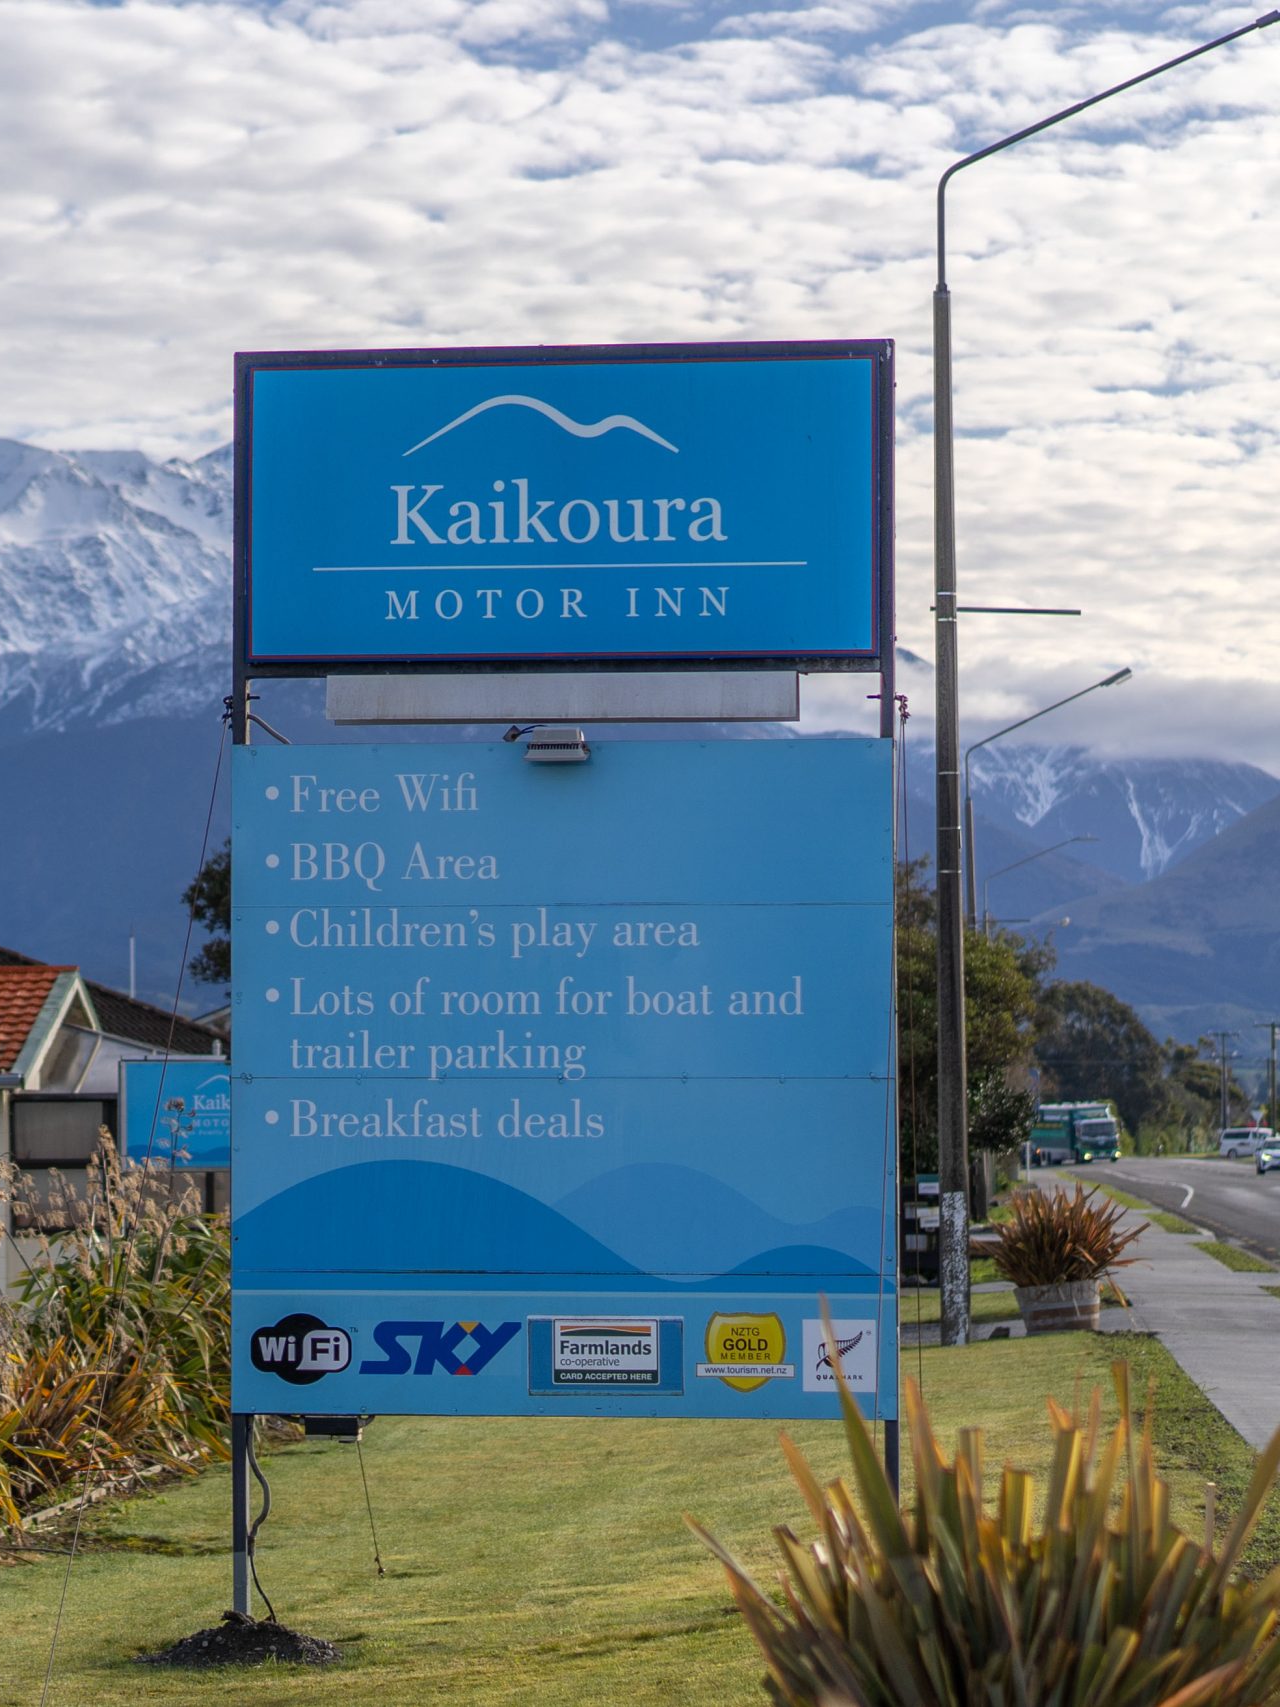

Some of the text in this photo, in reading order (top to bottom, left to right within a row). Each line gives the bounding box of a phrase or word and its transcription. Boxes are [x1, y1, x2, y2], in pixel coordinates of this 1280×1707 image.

[390, 479, 728, 545] Kaikoura
[385, 586, 730, 620] MOTOR INN
[290, 772, 479, 813] Free Wifi
[290, 842, 499, 891] BBQ Area
[290, 908, 701, 958] Children's play area
[290, 976, 804, 1016] Lots of room for boat and
[290, 1030, 586, 1080] trailer parking
[290, 1098, 605, 1138] Breakfast deals
[359, 1321, 522, 1375] SKY
[560, 1340, 652, 1355] Farmlands
[723, 1339, 768, 1351] GOLD
[731, 1327, 760, 1336] NZTG
[560, 1357, 620, 1367] co-operative
[704, 1366, 787, 1374] www.tourism.net.nz
[720, 1352, 771, 1361] MEMBER
[560, 1372, 652, 1381] CARD ACCEPTED HERE
[815, 1374, 864, 1382] QUAARK
